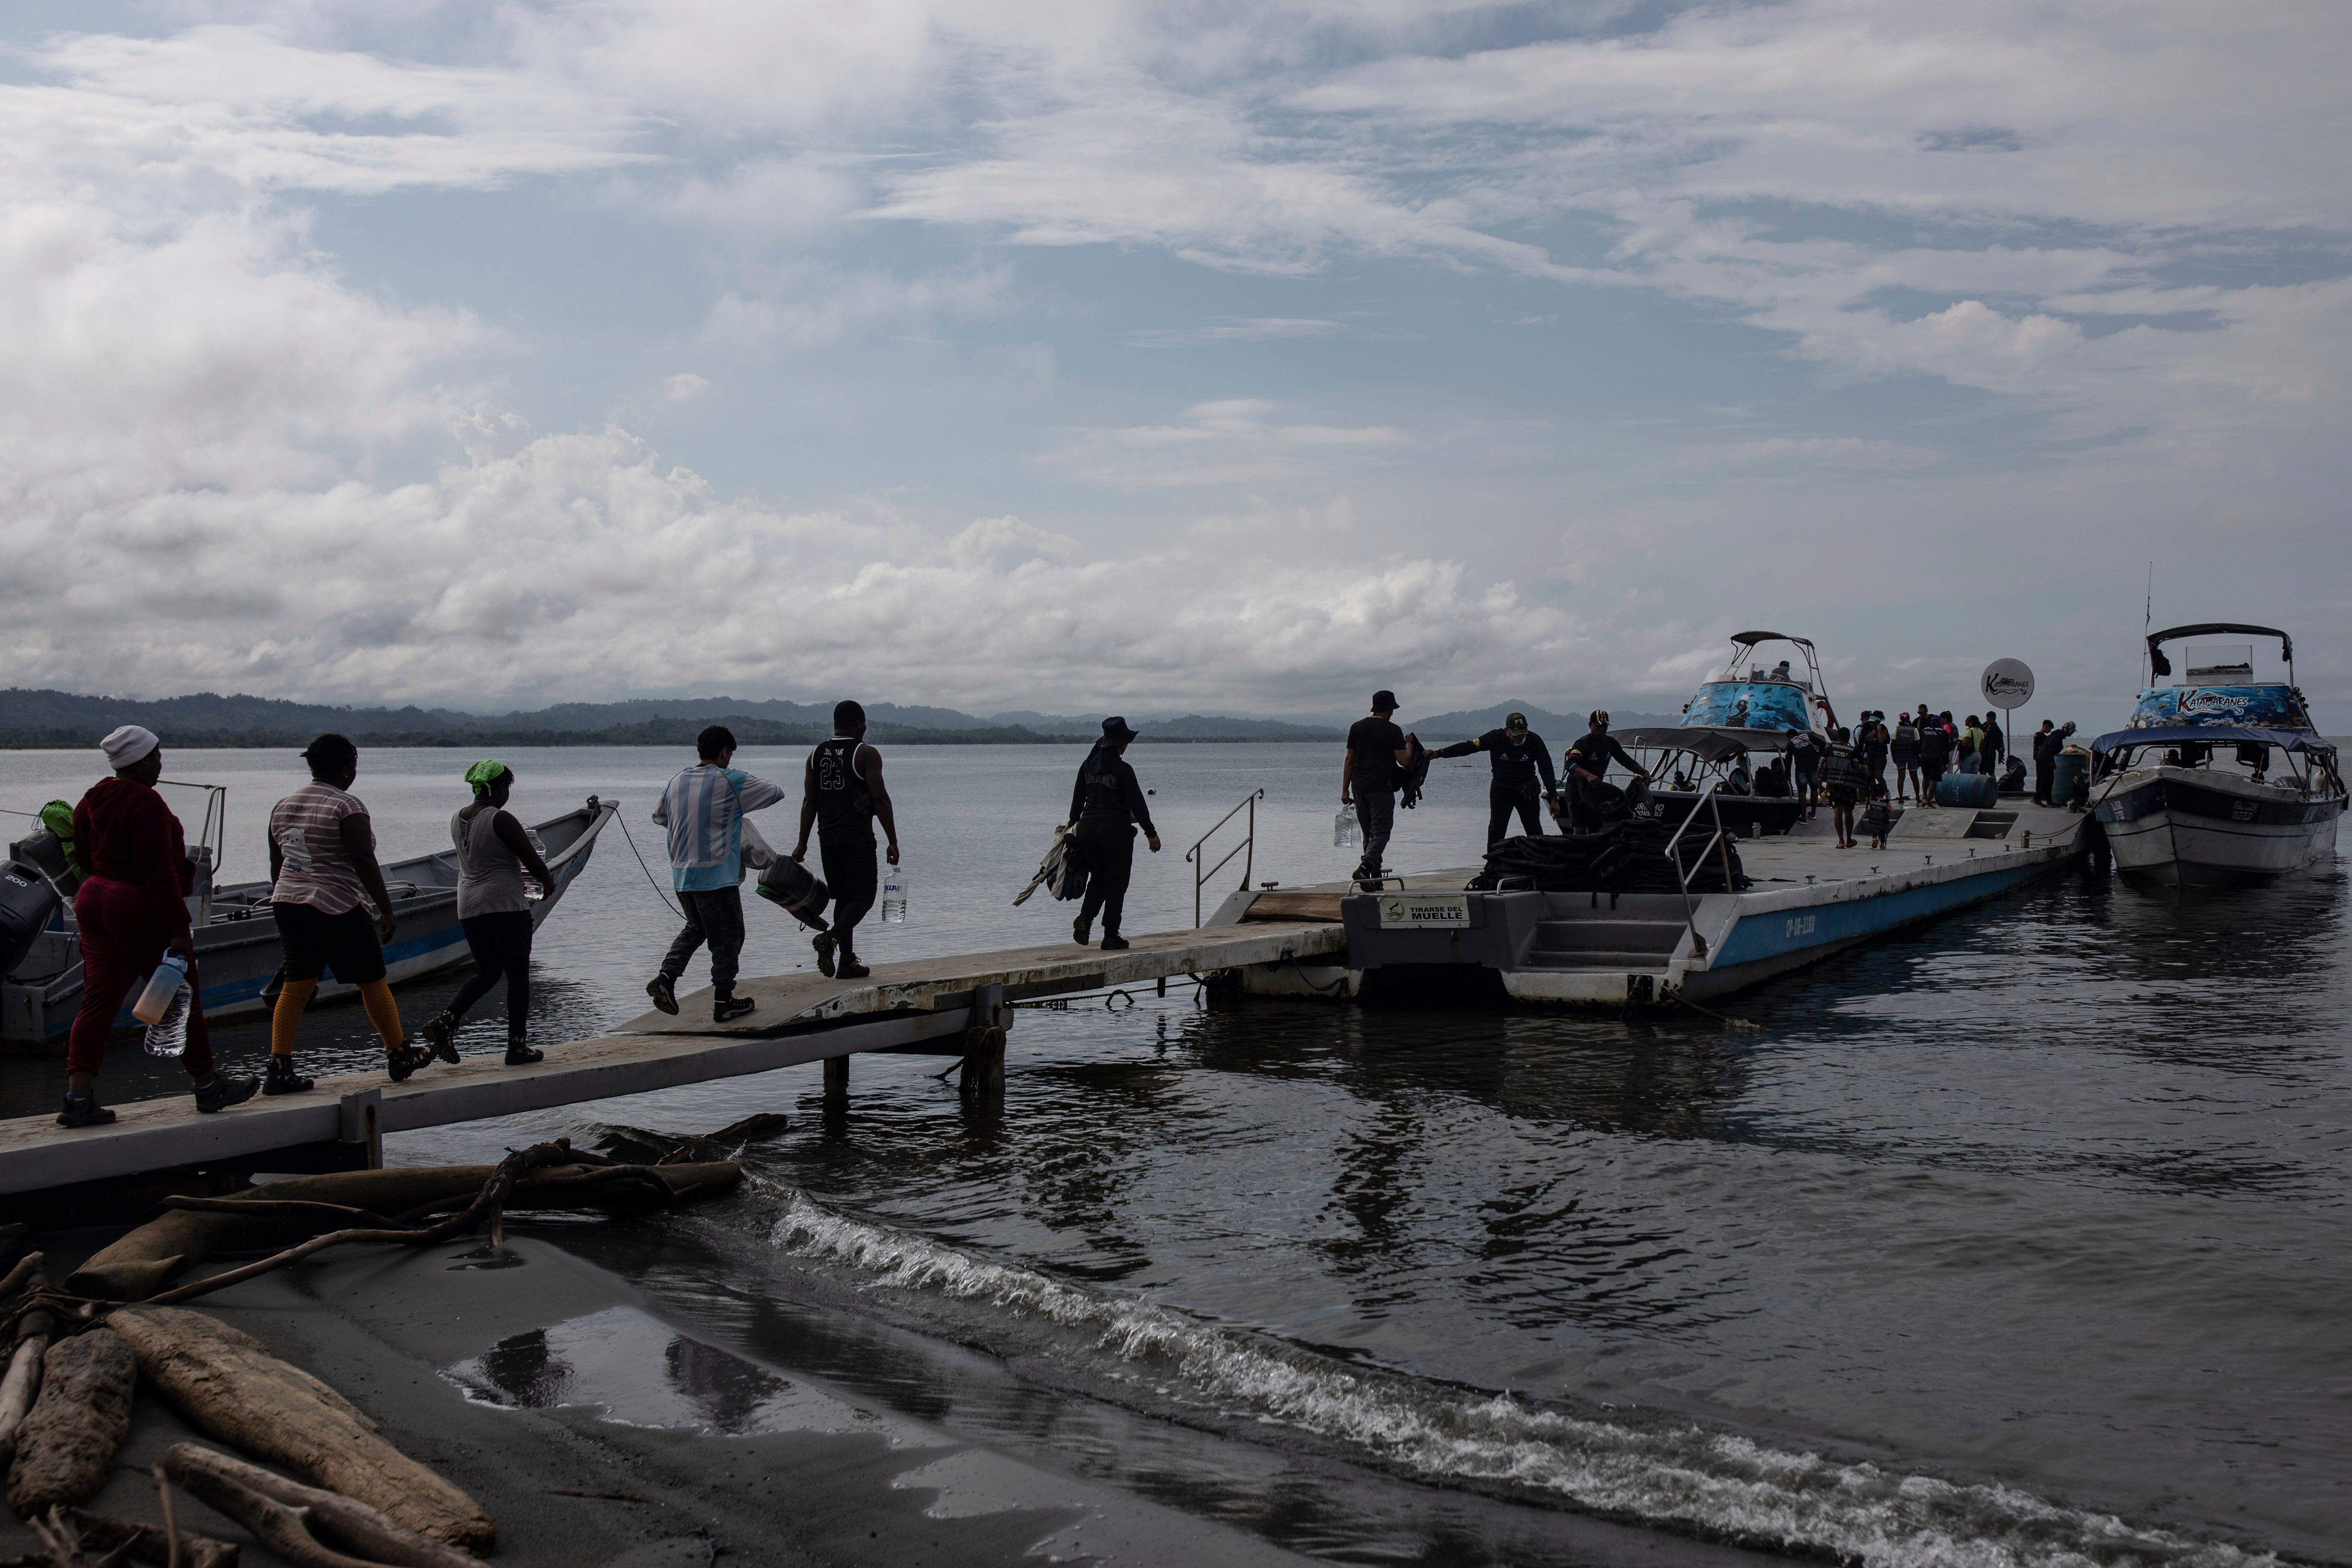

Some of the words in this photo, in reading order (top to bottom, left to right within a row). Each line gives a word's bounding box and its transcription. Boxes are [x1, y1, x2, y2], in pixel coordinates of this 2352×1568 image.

[1985, 673, 2029, 692] KATAMARANES
[2177, 689, 2247, 712] KATAMARANES
[824, 748, 844, 756] JOAN
[820, 758, 845, 789] 23
[5, 875, 27, 887] 200
[1786, 915, 1815, 938] CP-08-1160
